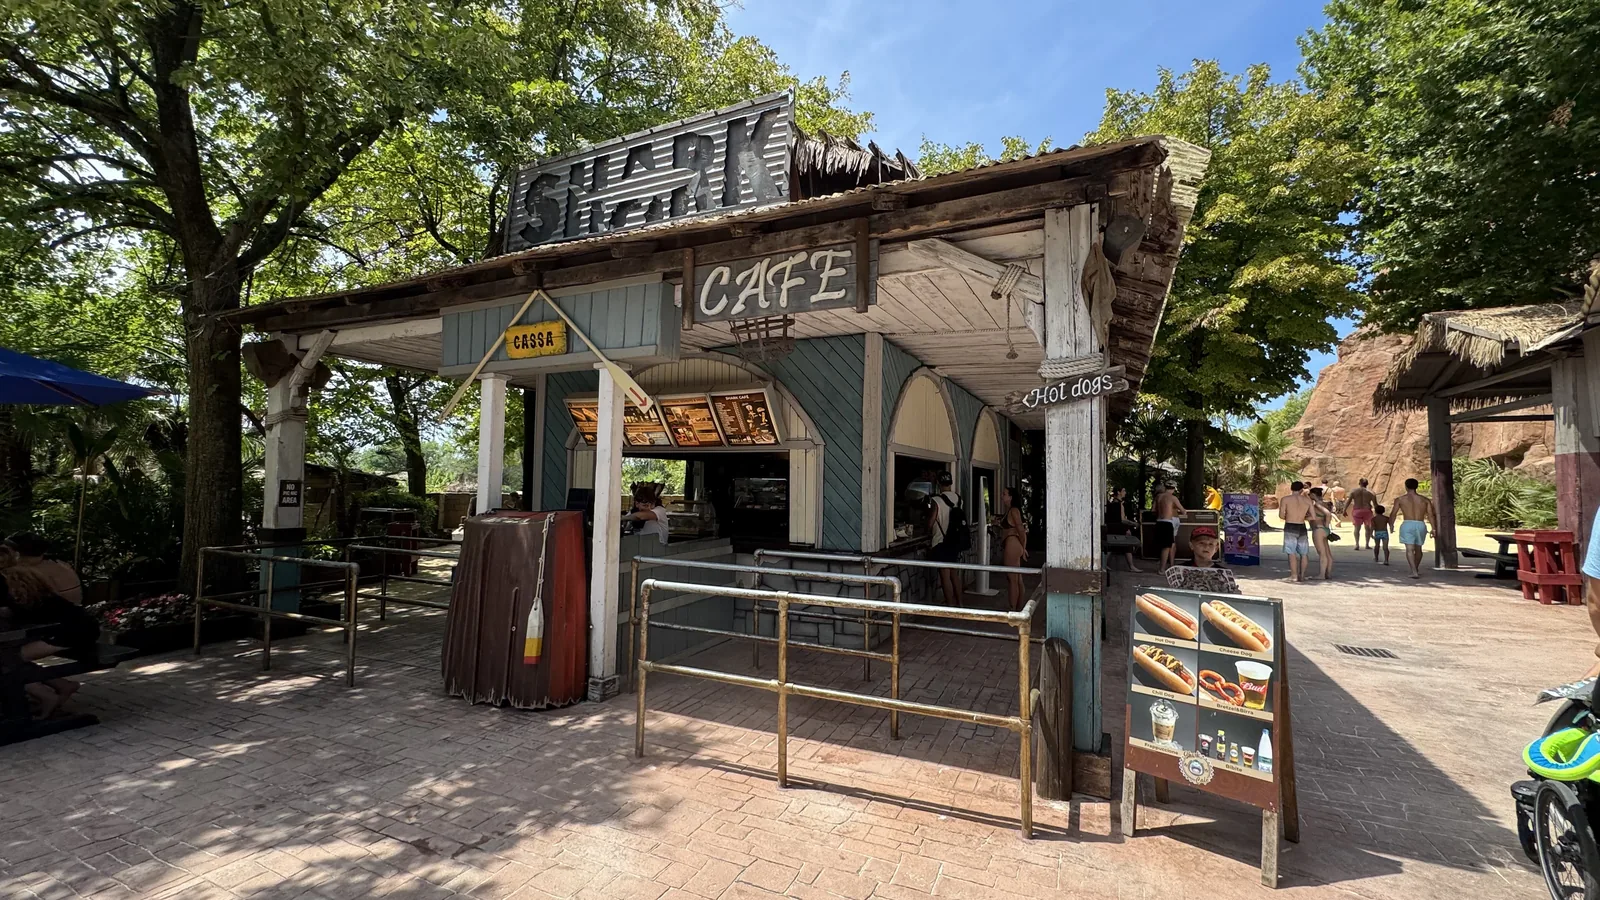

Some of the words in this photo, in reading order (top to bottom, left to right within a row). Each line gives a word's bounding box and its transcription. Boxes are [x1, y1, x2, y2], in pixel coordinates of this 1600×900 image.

[519, 107, 783, 244] SHARK
[700, 248, 853, 316] CAFE
[513, 330, 554, 350] CASSA
[1030, 381, 1068, 408] Hot
[1071, 374, 1113, 397] dogs
[1219, 647, 1240, 655] Cheese
[1241, 682, 1266, 692] Bud
[1226, 763, 1242, 772] Bibite
